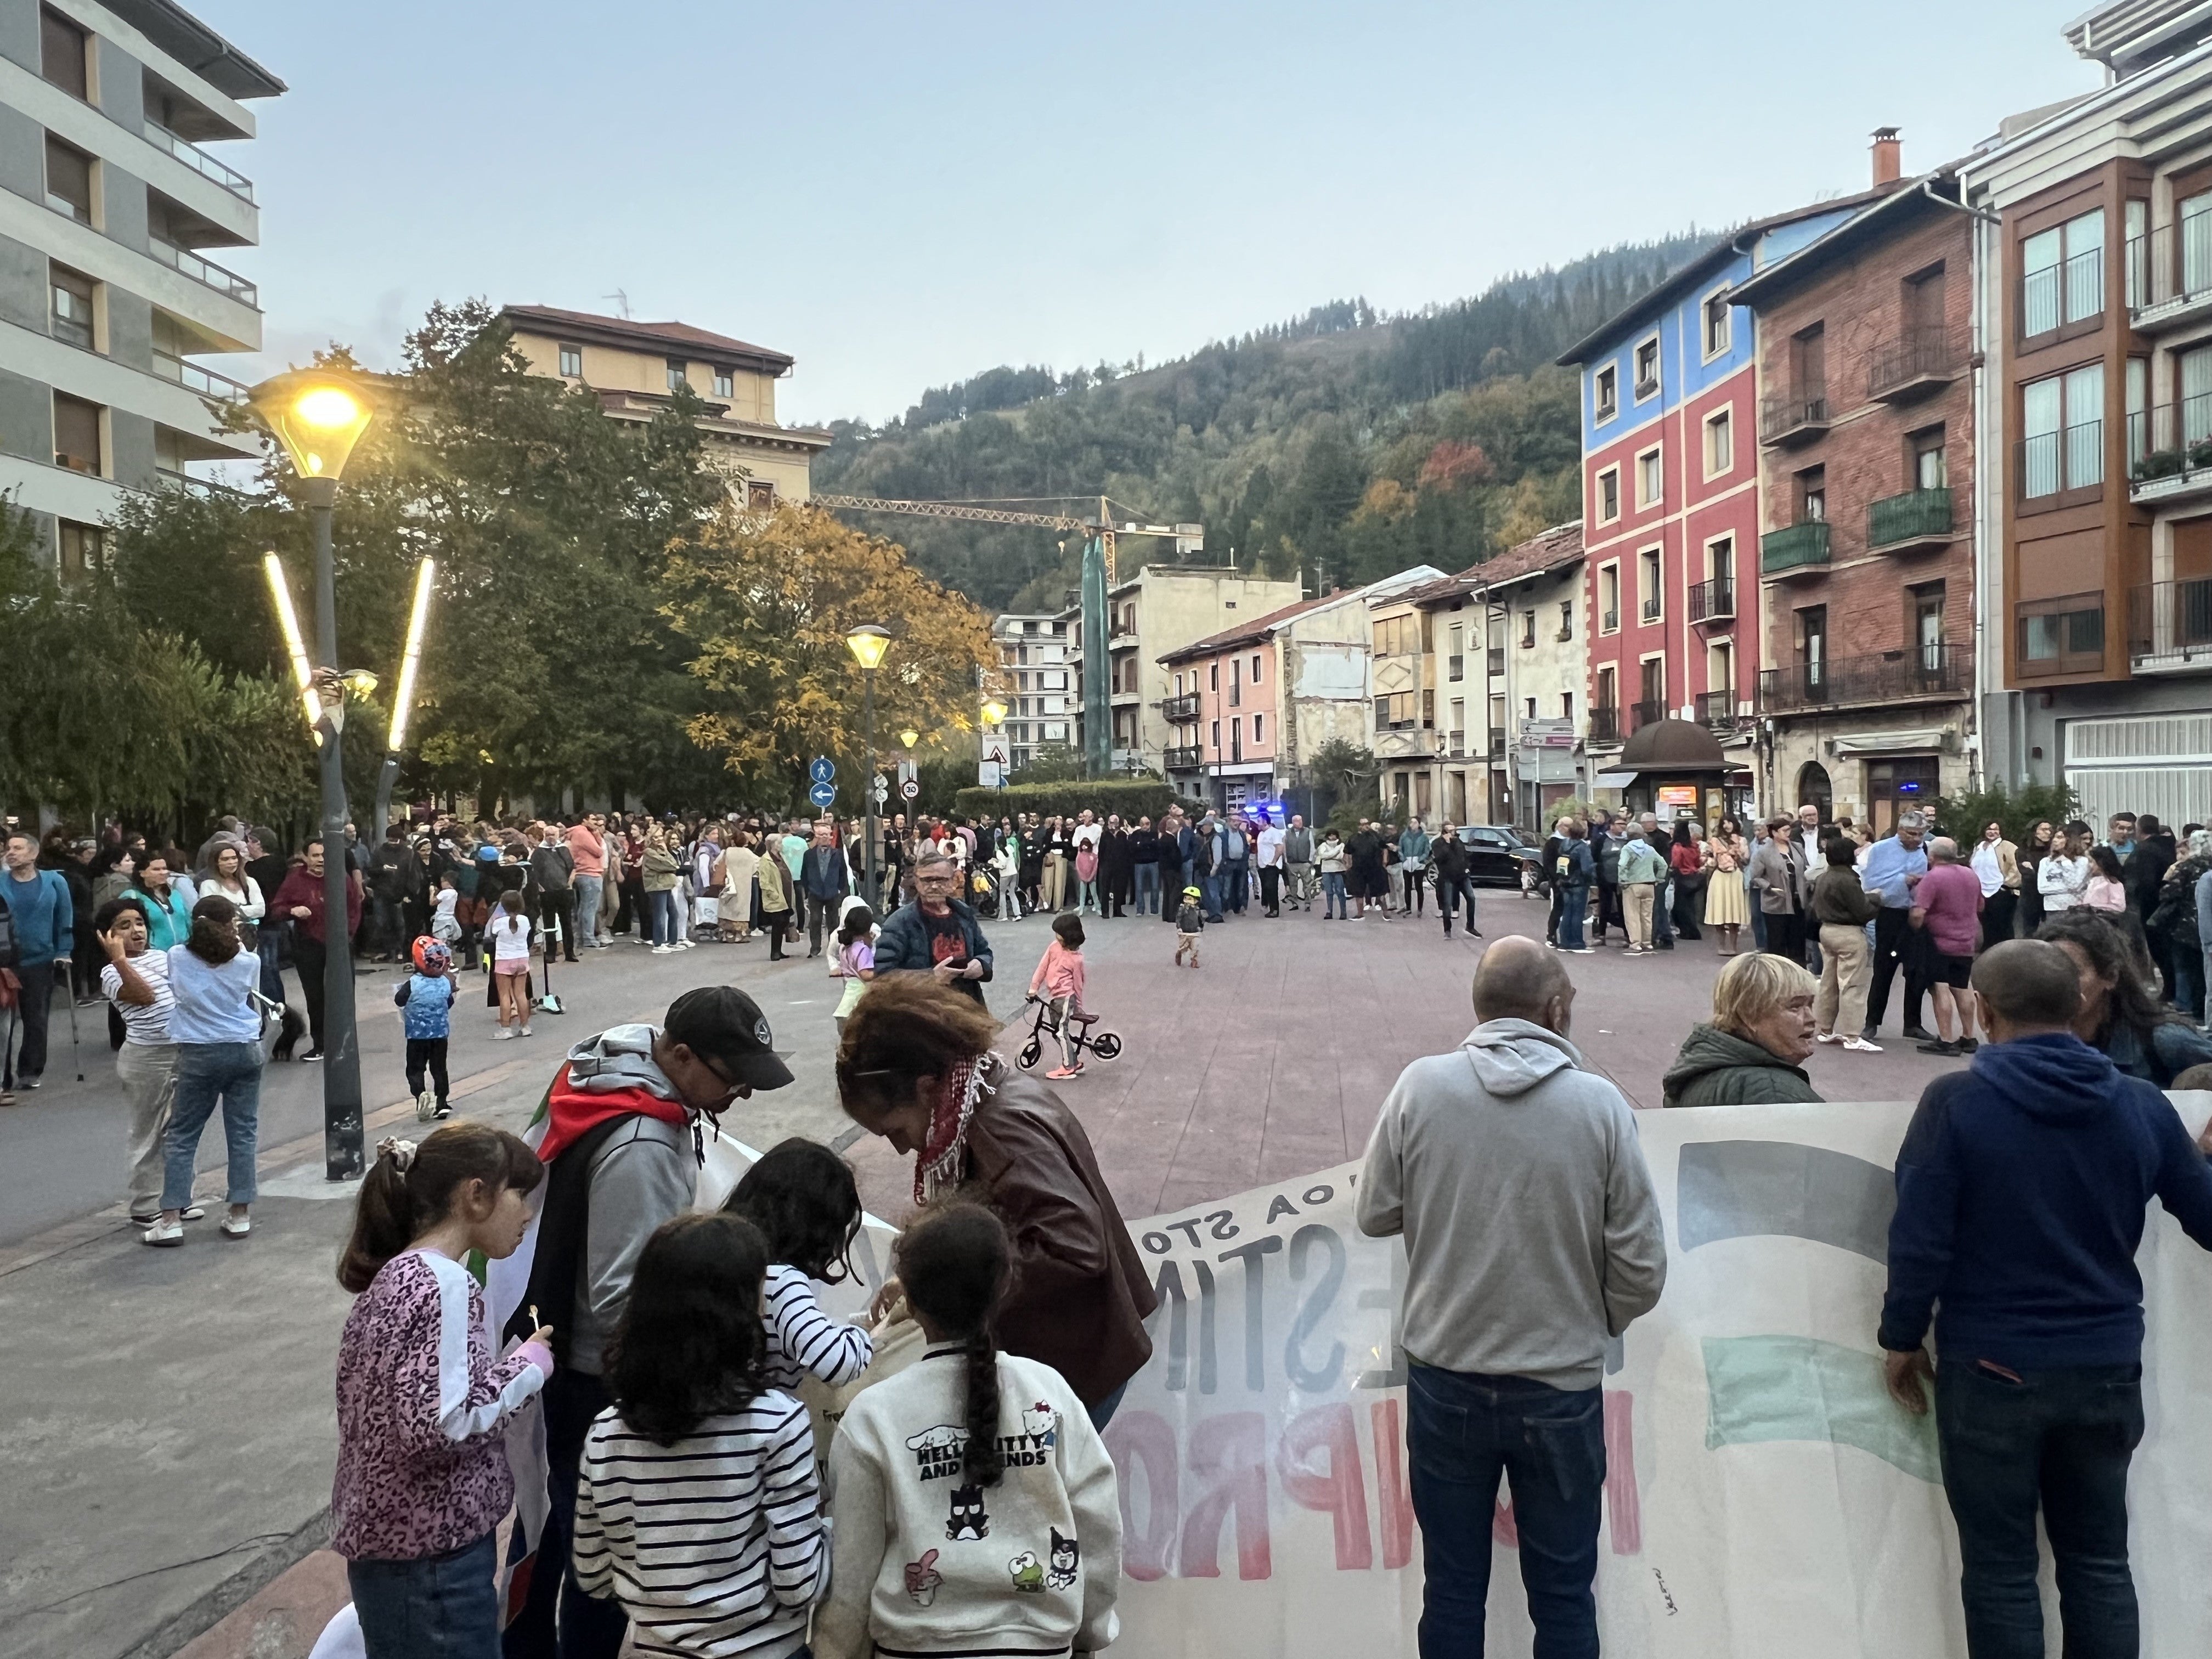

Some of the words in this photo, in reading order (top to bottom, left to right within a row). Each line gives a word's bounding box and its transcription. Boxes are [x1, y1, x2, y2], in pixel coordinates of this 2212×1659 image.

[917, 1445, 964, 1465] HELL
[996, 1435, 1043, 1452] ITTY
[920, 1462, 960, 1481] AND
